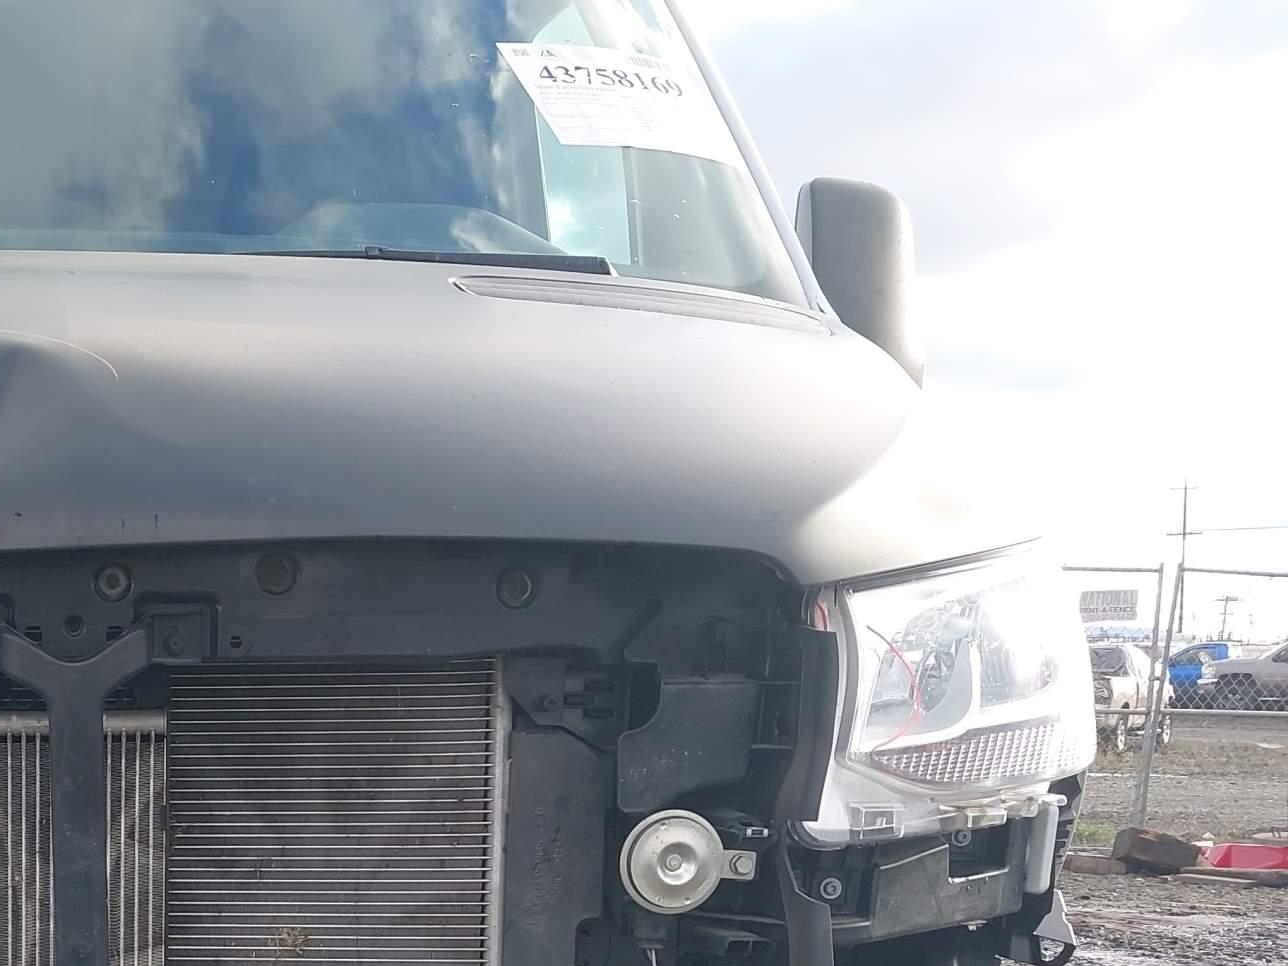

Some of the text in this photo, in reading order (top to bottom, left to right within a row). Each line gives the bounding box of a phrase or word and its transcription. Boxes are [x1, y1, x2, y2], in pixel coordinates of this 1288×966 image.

[539, 65, 683, 97] 43758169
[1080, 590, 1137, 606] NATIONAL
[1080, 606, 1136, 614] RENT-A-FENCE
